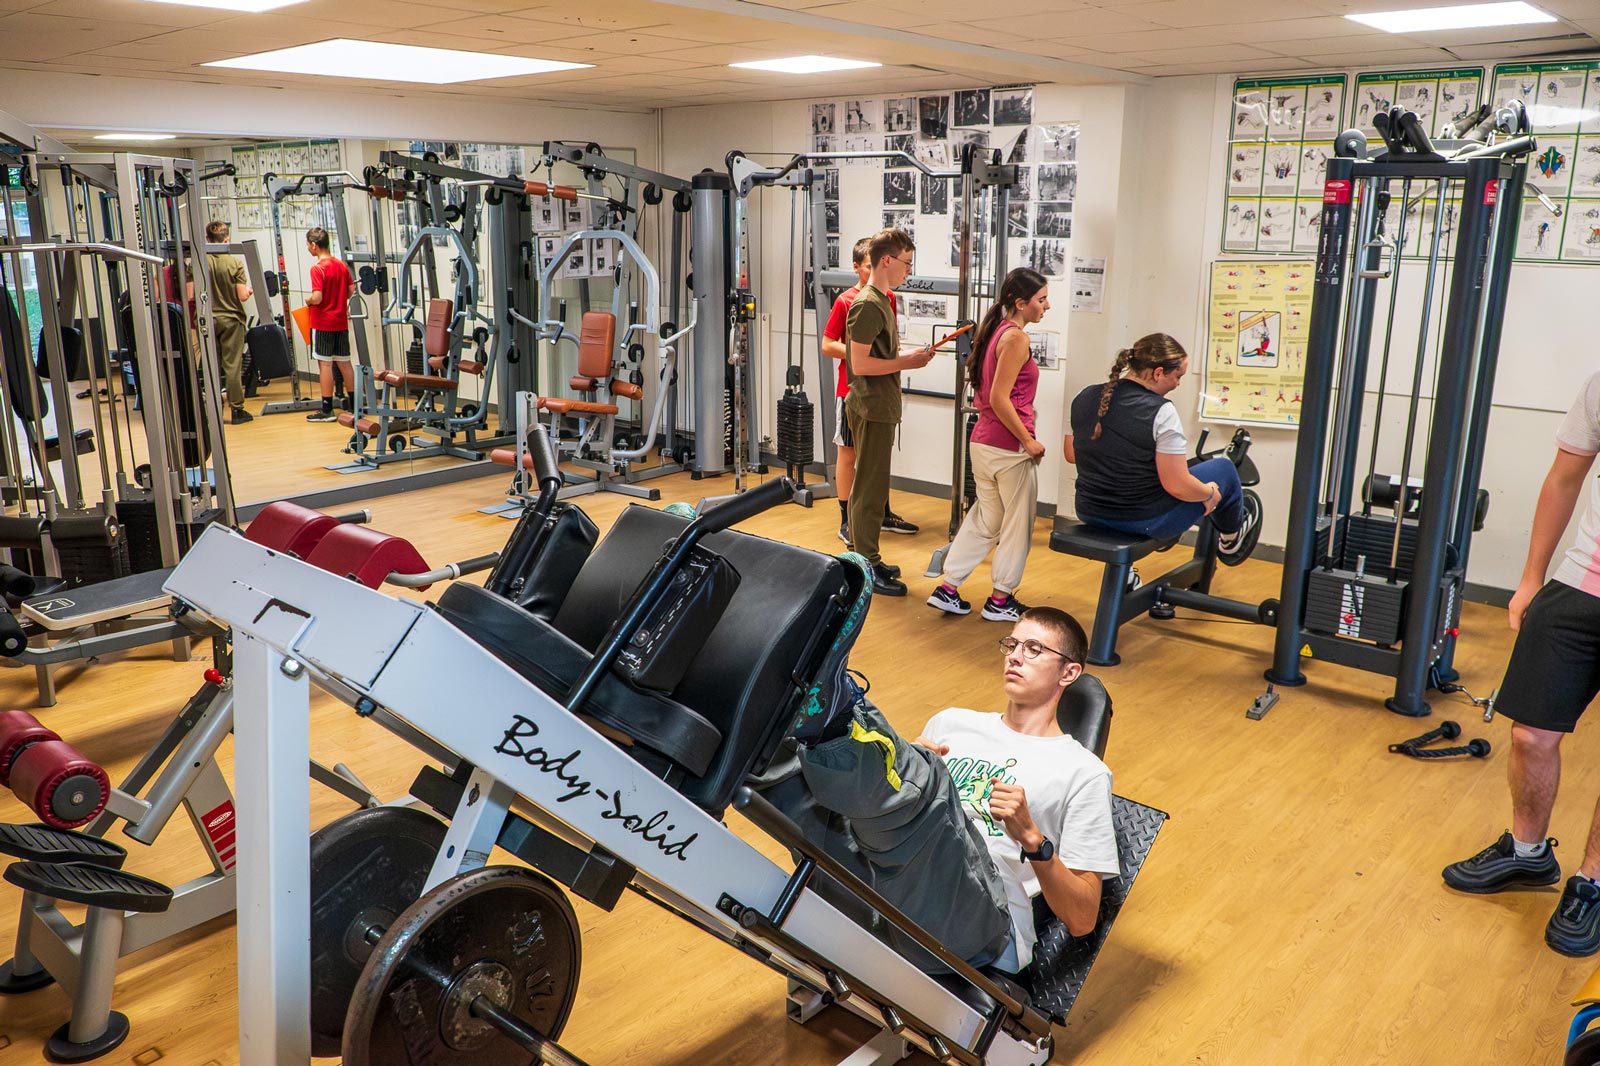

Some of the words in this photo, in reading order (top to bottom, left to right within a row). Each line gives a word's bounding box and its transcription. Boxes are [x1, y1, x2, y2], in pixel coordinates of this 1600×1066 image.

[134, 203, 144, 250] POWER
[140, 261, 150, 306] FITNES
[896, 279, 934, 290] -Solid
[493, 714, 699, 861] Body-Solid
